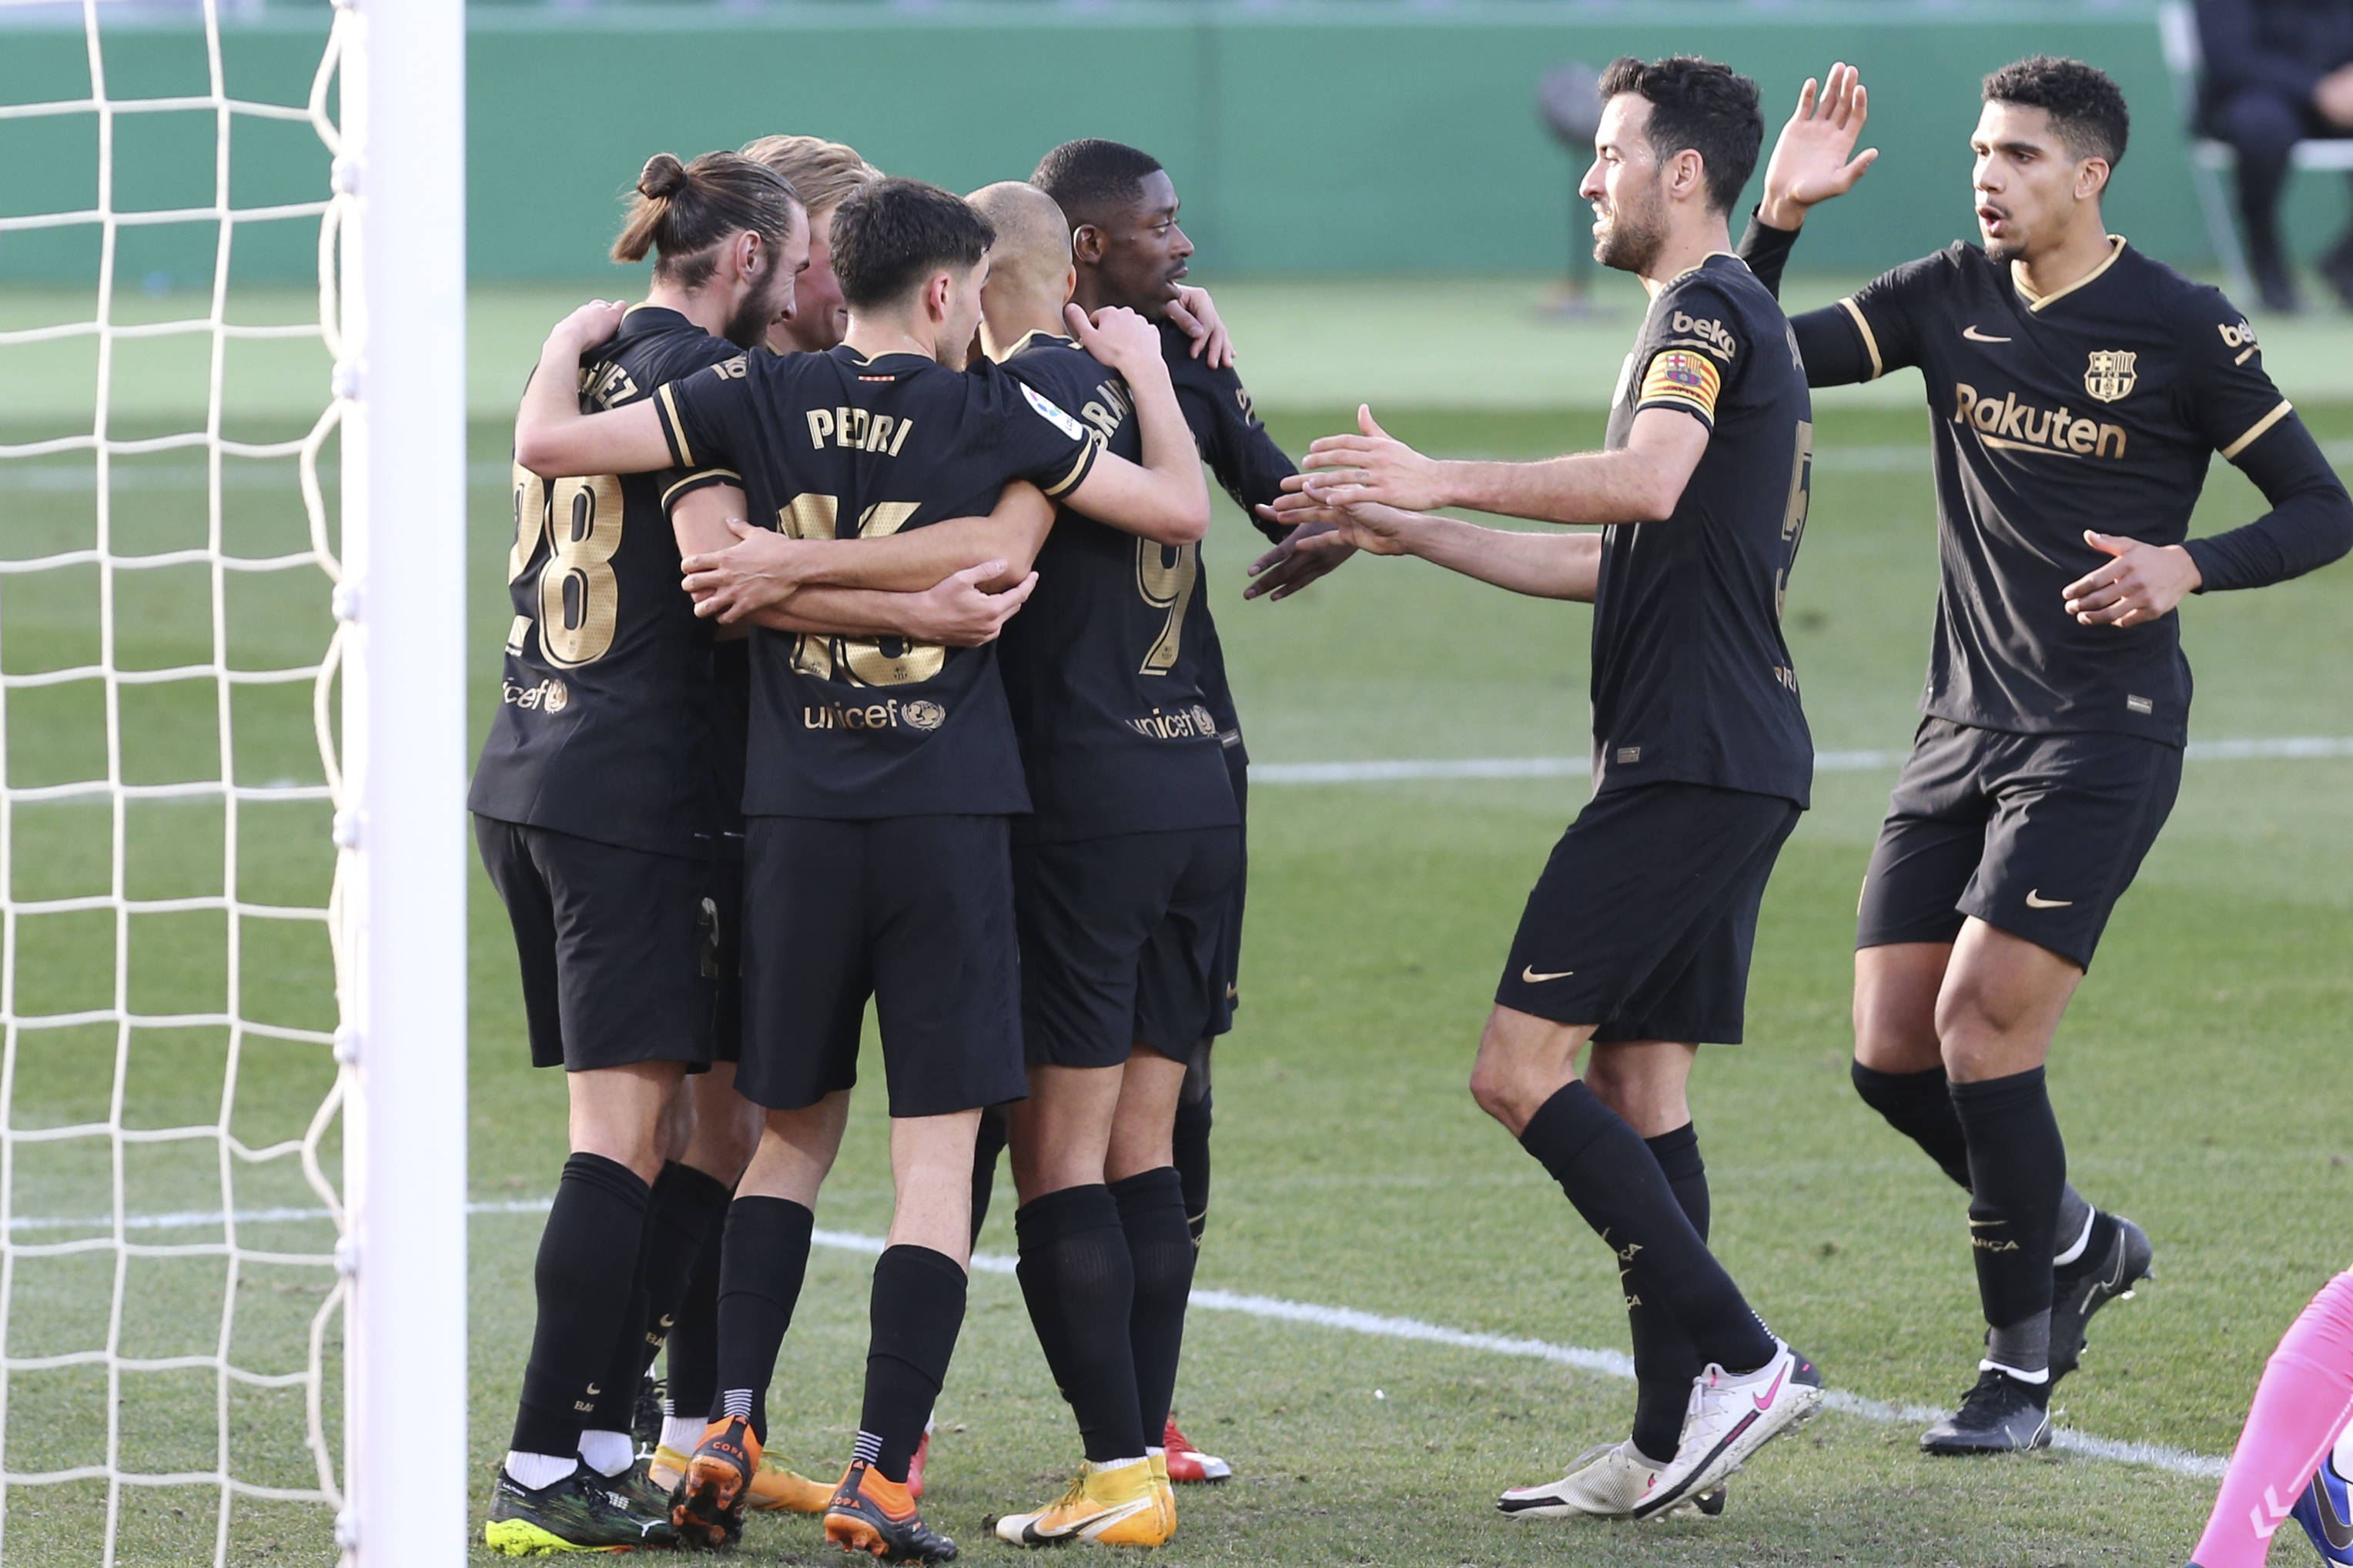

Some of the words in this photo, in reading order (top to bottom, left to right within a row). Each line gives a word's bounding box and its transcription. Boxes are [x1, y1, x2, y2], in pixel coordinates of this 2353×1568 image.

[1672, 310, 1737, 358] beko
[2217, 317, 2256, 348] be
[805, 406, 914, 458] PEDRI
[1953, 382, 2127, 459] Rakuten
[803, 699, 898, 730] unicef
[1124, 707, 1195, 739] unicef
[712, 1440, 744, 1460] COPA
